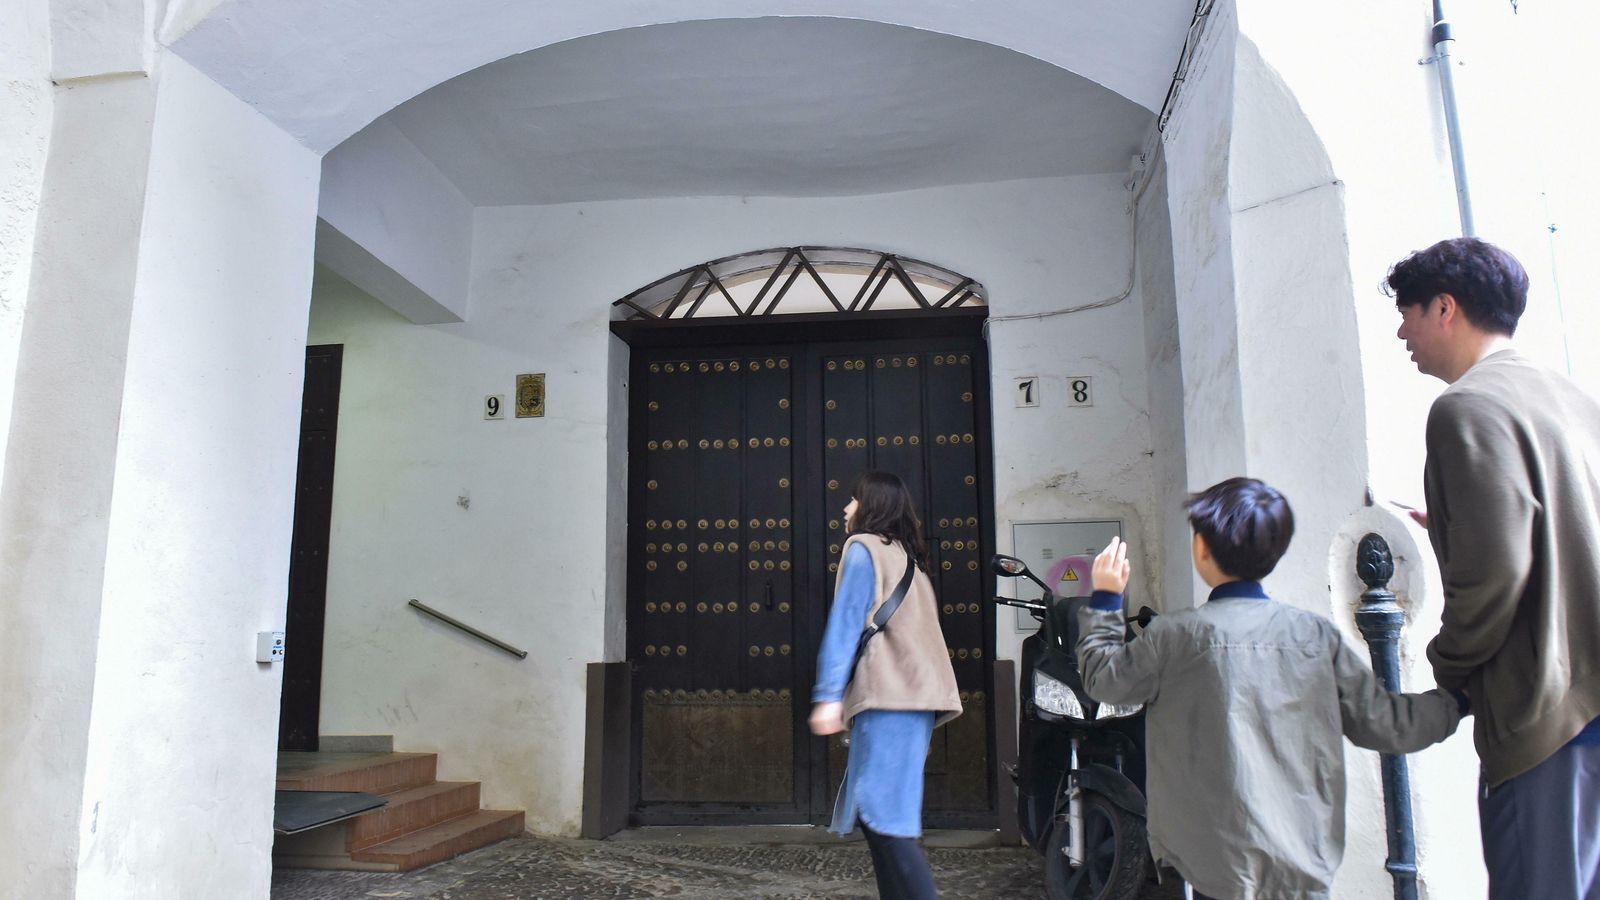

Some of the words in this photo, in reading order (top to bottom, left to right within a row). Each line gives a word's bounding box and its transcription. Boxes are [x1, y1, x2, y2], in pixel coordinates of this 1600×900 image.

[1019, 380, 1033, 403] 7
[1072, 380, 1087, 402] 8
[487, 396, 499, 416] 9
